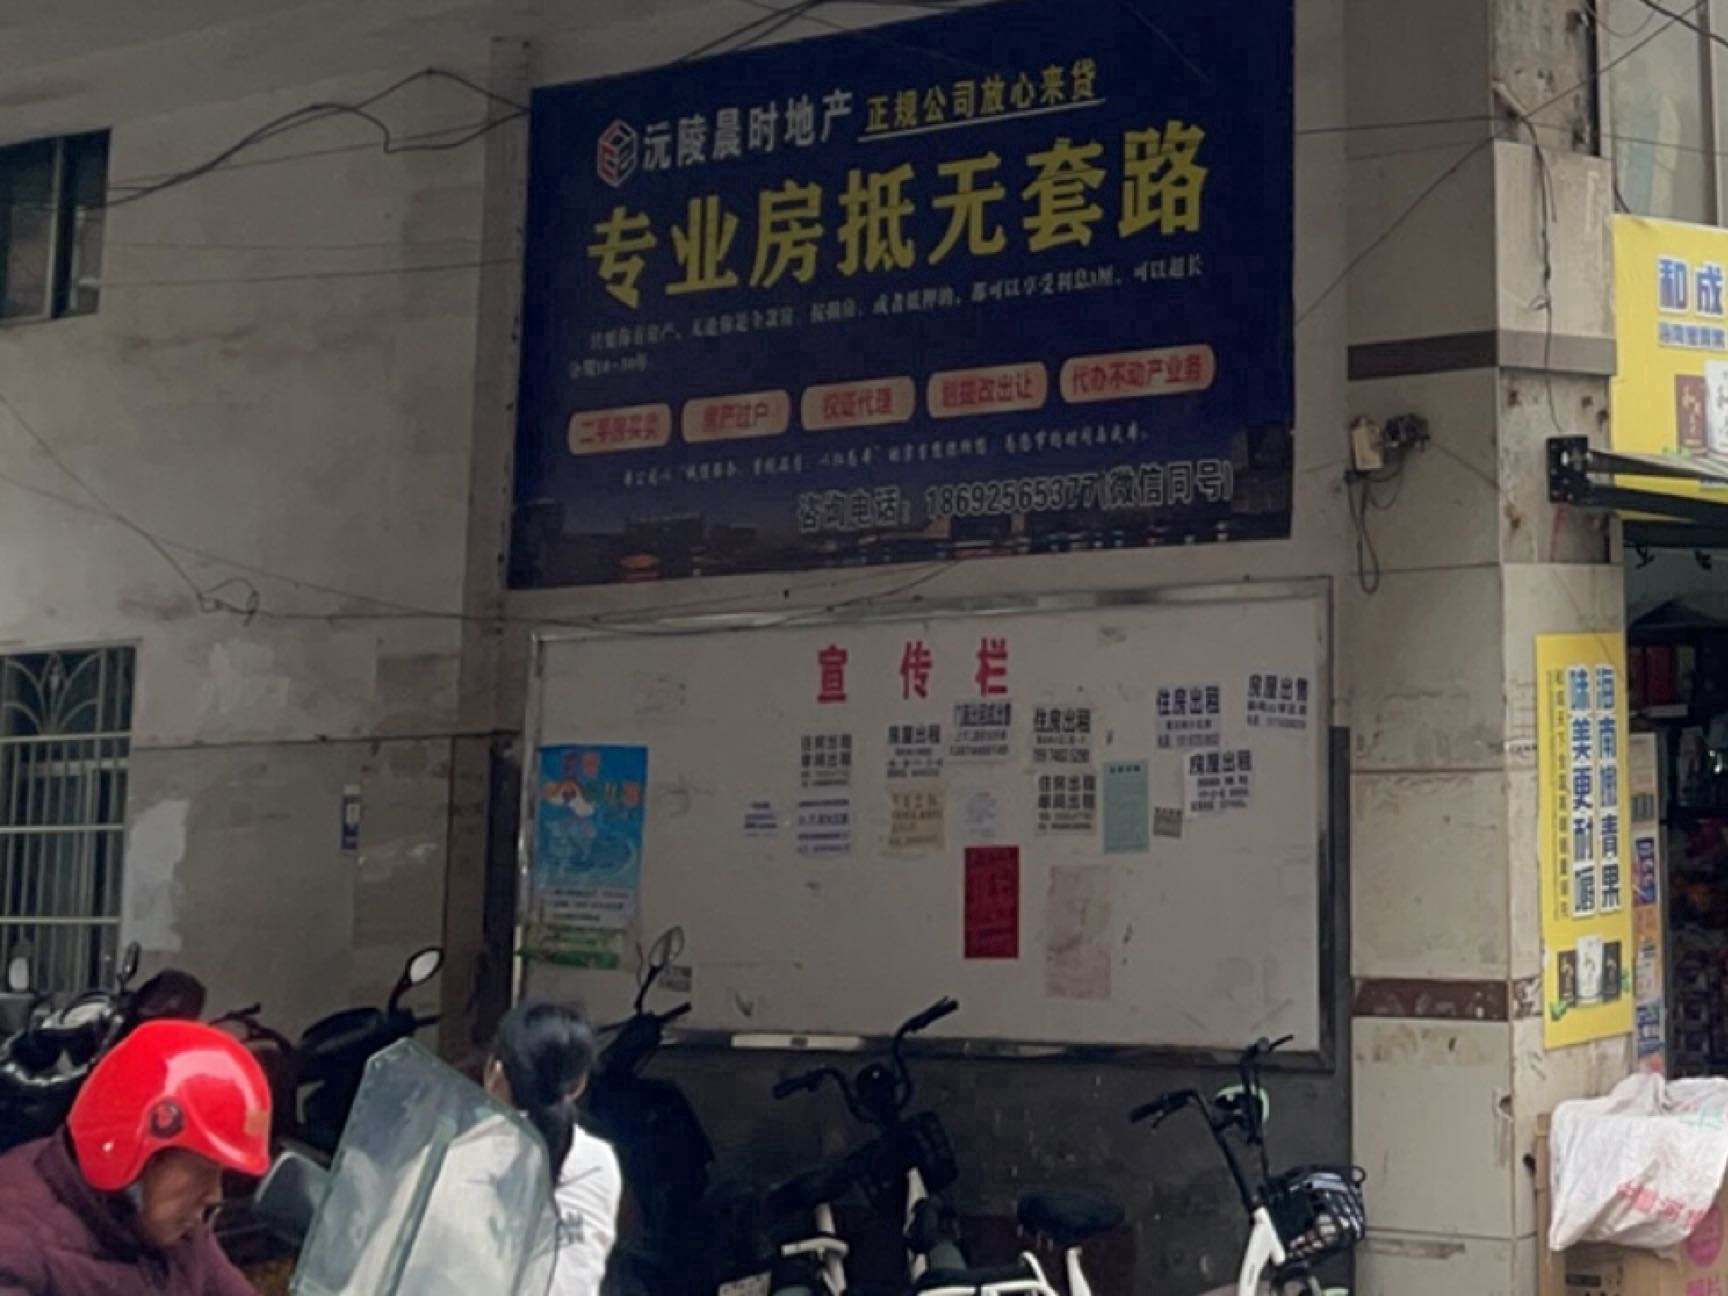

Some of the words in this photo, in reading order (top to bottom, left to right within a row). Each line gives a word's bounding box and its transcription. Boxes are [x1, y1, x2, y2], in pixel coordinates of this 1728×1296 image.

[642, 89, 853, 171] 沅陵晨时地产
[587, 120, 1210, 309] 专业房抵无套路
[1069, 351, 1207, 396] 代办不动产业务
[816, 637, 1010, 704] 宣传栏
